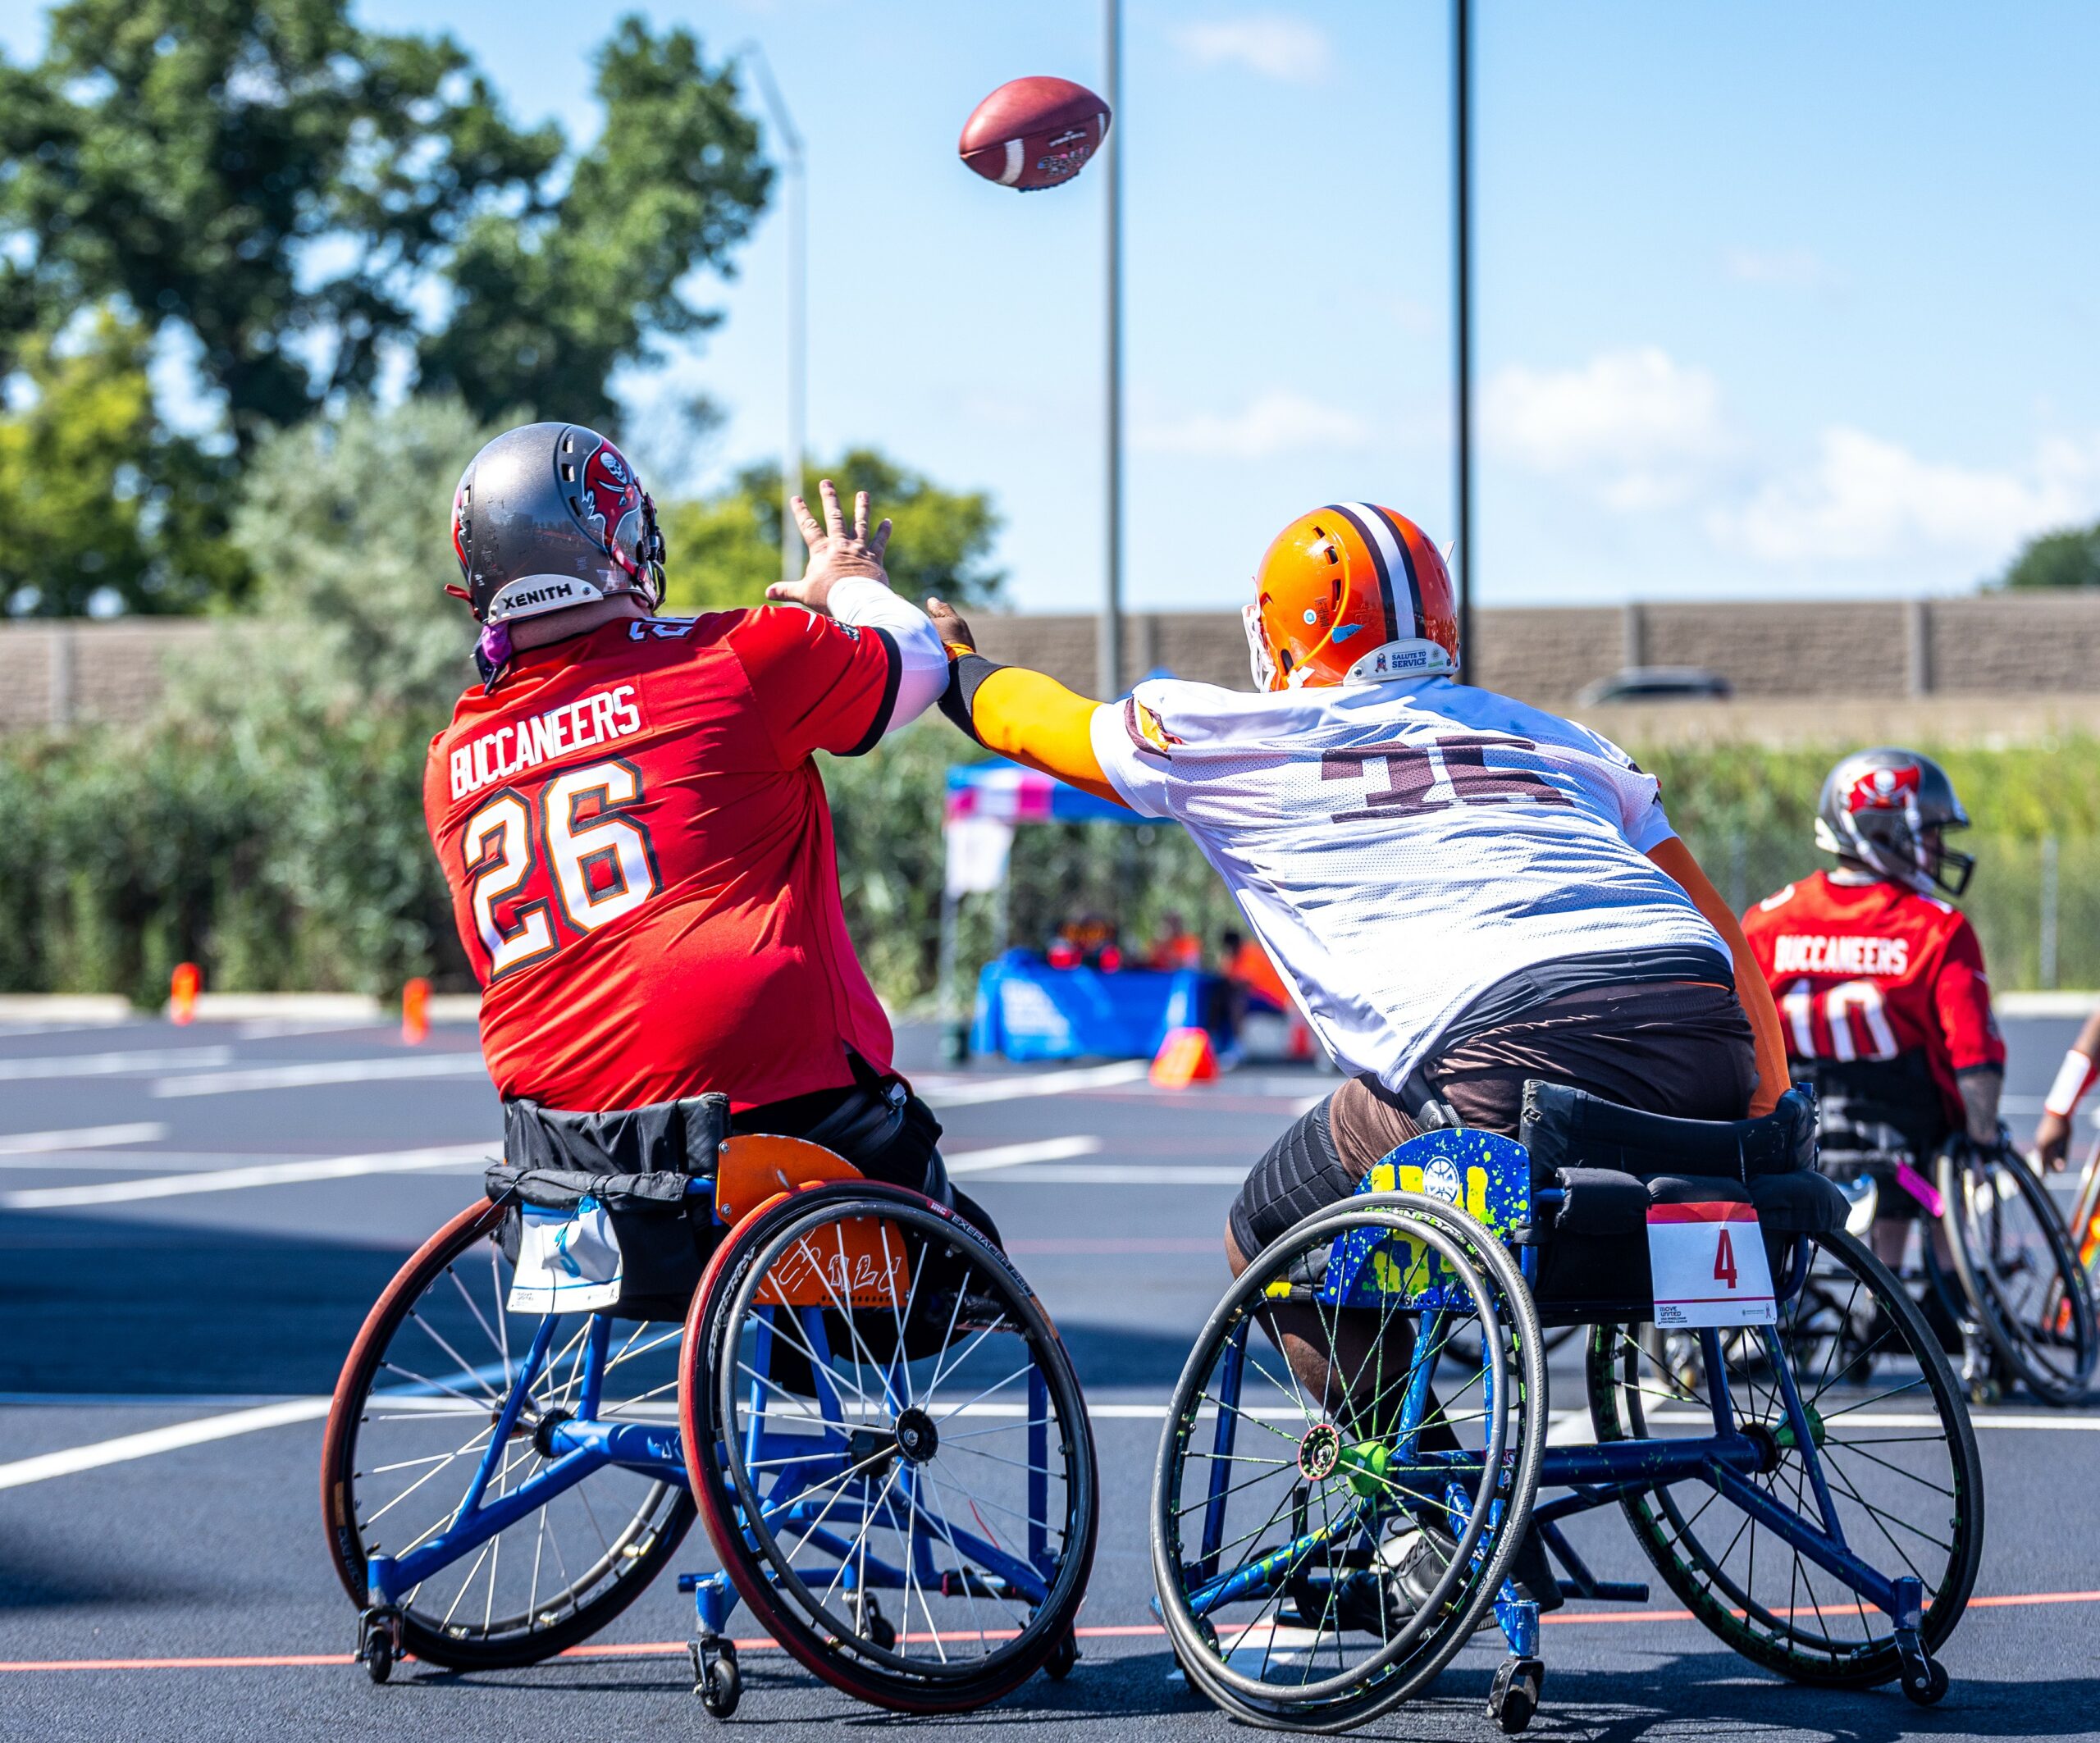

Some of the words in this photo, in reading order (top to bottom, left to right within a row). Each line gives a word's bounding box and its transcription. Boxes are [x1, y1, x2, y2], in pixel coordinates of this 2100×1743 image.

[501, 583, 573, 610] XENITH
[1392, 652, 1418, 660] SALUTE
[1392, 658, 1427, 668] SERVICE
[451, 685, 641, 801] BUCCANEERS
[461, 754, 664, 983] 26
[1774, 934, 1908, 976] BUCCANEERS
[1782, 978, 1900, 1062] 10
[1714, 1229, 1737, 1289] 4
